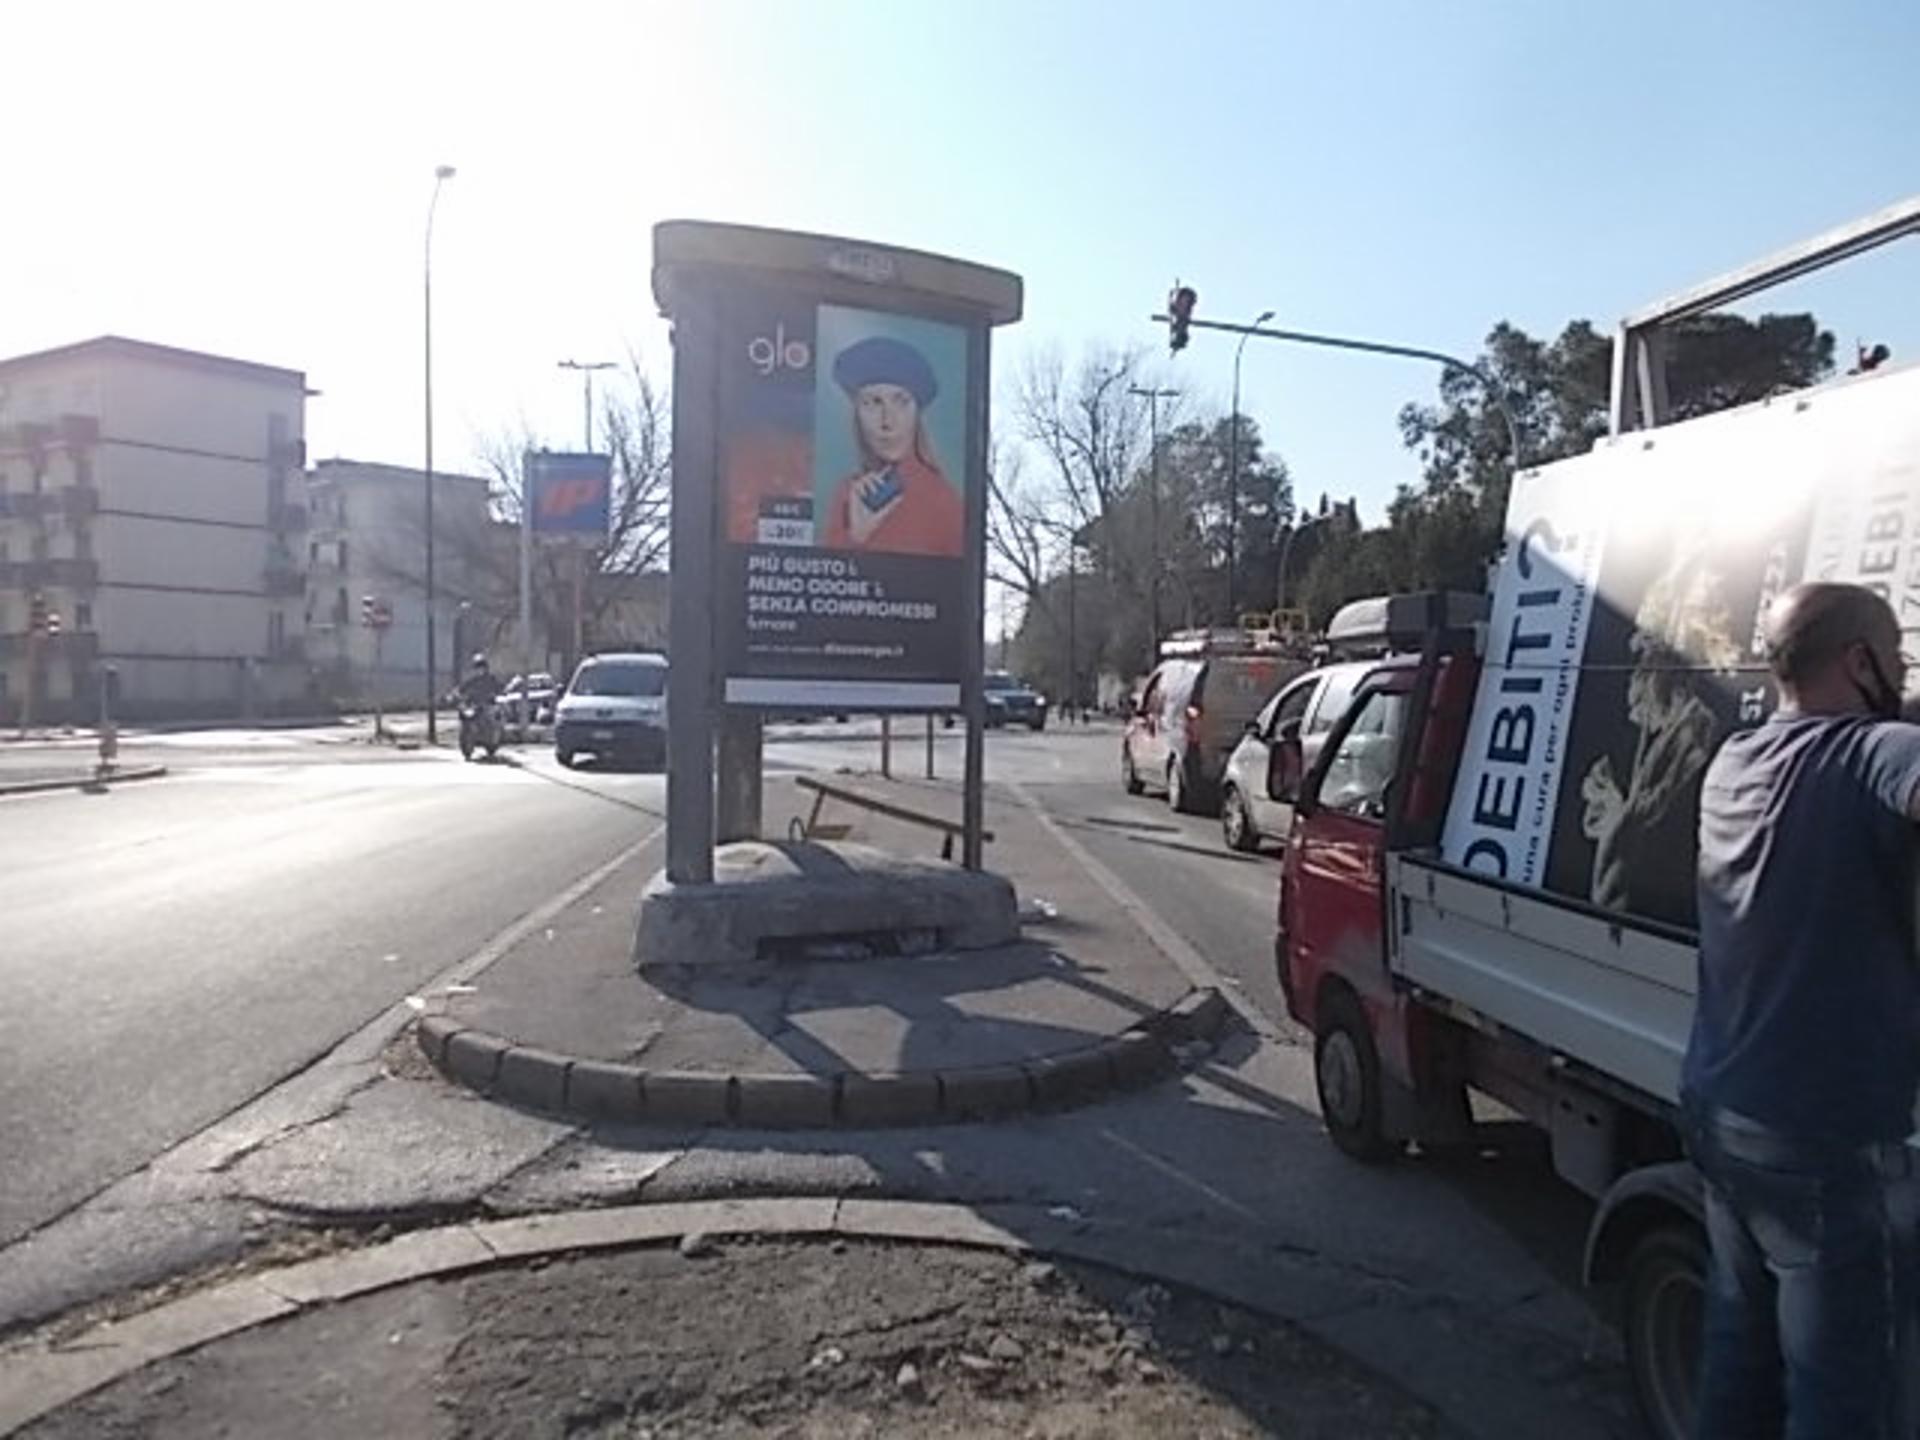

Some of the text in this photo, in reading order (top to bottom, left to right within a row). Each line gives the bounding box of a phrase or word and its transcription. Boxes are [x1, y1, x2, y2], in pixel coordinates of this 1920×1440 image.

[748, 319, 810, 375] glo
[747, 575, 805, 594] MENO
[807, 579, 869, 598] ODORE
[748, 551, 780, 573] PIÙ
[783, 557, 846, 577] GUSTO
[747, 595, 938, 620] SENZA COMPROMESSI
[1462, 517, 1579, 878] DEBITI?
[1552, 658, 1574, 715] ogni
[1541, 723, 1558, 766] per
[1532, 772, 1552, 826] cura
[1522, 836, 1541, 883] una
